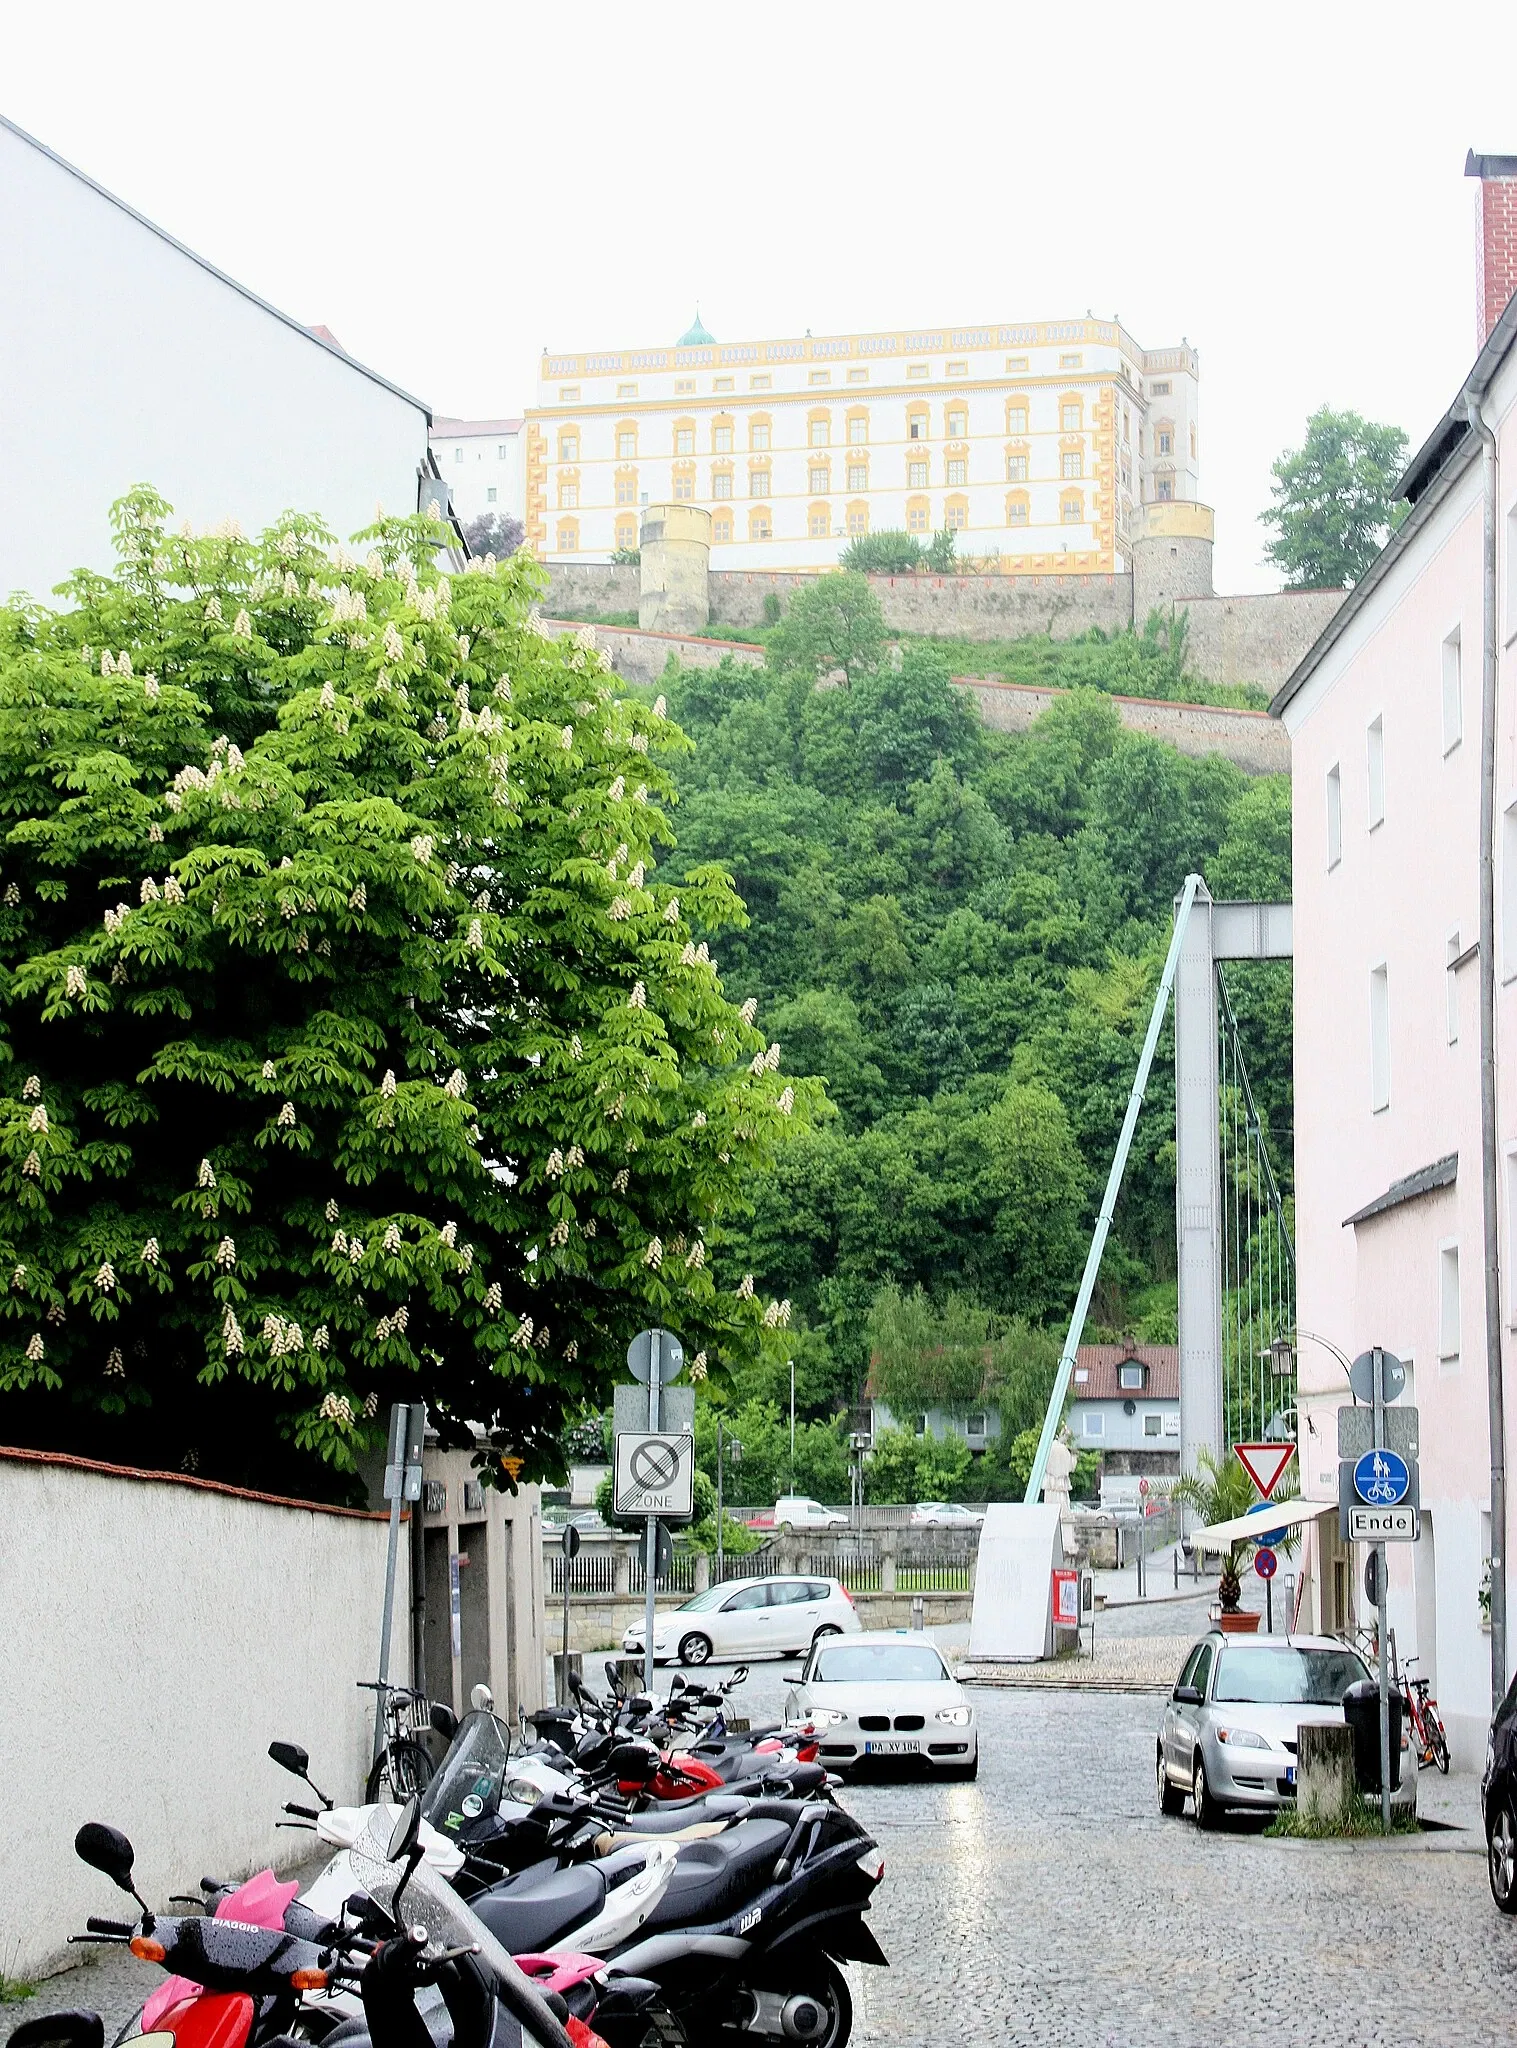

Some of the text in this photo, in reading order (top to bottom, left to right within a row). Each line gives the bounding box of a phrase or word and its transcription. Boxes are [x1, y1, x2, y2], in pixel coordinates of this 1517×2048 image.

[635, 1495, 673, 1508] ZONE
[1355, 1514, 1407, 1530] Ende
[871, 1742, 884, 1753] PA
[889, 1742, 900, 1753] XY
[211, 1918, 259, 1934] PIAGGIO
